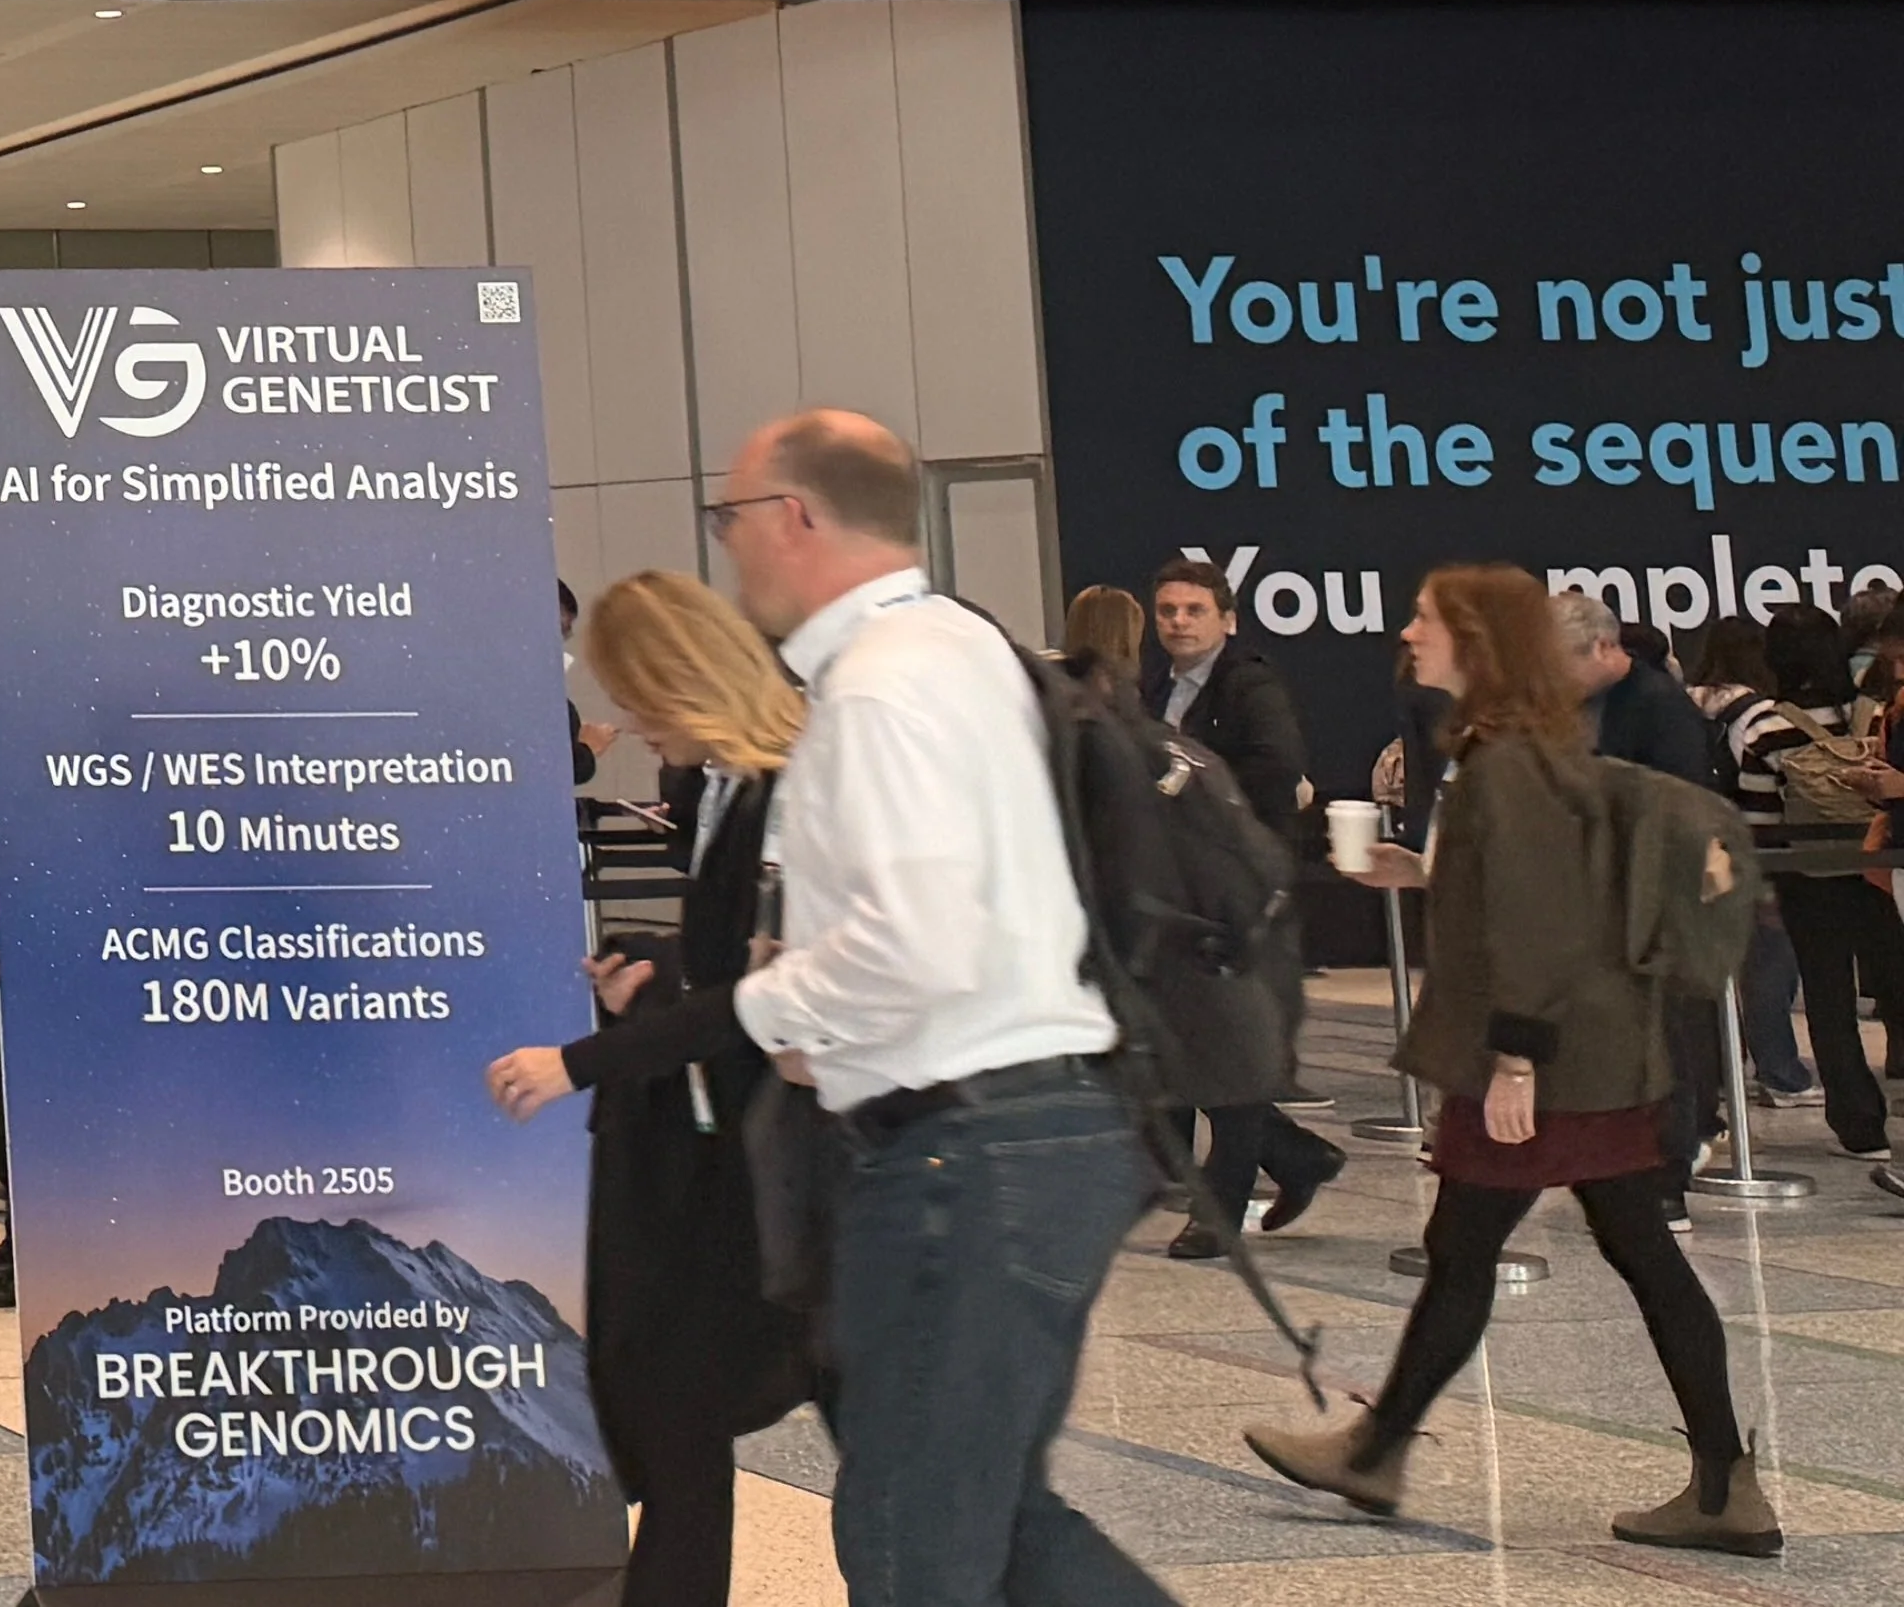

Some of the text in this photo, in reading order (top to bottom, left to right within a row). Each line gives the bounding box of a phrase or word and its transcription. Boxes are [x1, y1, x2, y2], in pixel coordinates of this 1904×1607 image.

[1157, 252, 1904, 368] You're not just
[217, 325, 423, 364] VIRTUAL
[222, 374, 500, 414] GENETICIST
[1177, 393, 1901, 510] of the sequen
[0, 462, 519, 510] AI for Simplified Analysis
[122, 582, 413, 627] Diagnostic Yield
[201, 637, 341, 682] +10%
[45, 750, 514, 792] WGS / WES Interpretation
[168, 809, 401, 853] 10 Minutes
[101, 923, 485, 962] ACMG Classifications
[142, 979, 451, 1023] 180M Variants
[222, 1166, 395, 1197] Booth 2505
[165, 1301, 470, 1335] Platform Provided by
[95, 1343, 547, 1401] BREAKTHROUGH
[174, 1405, 476, 1459] GENOMICS
